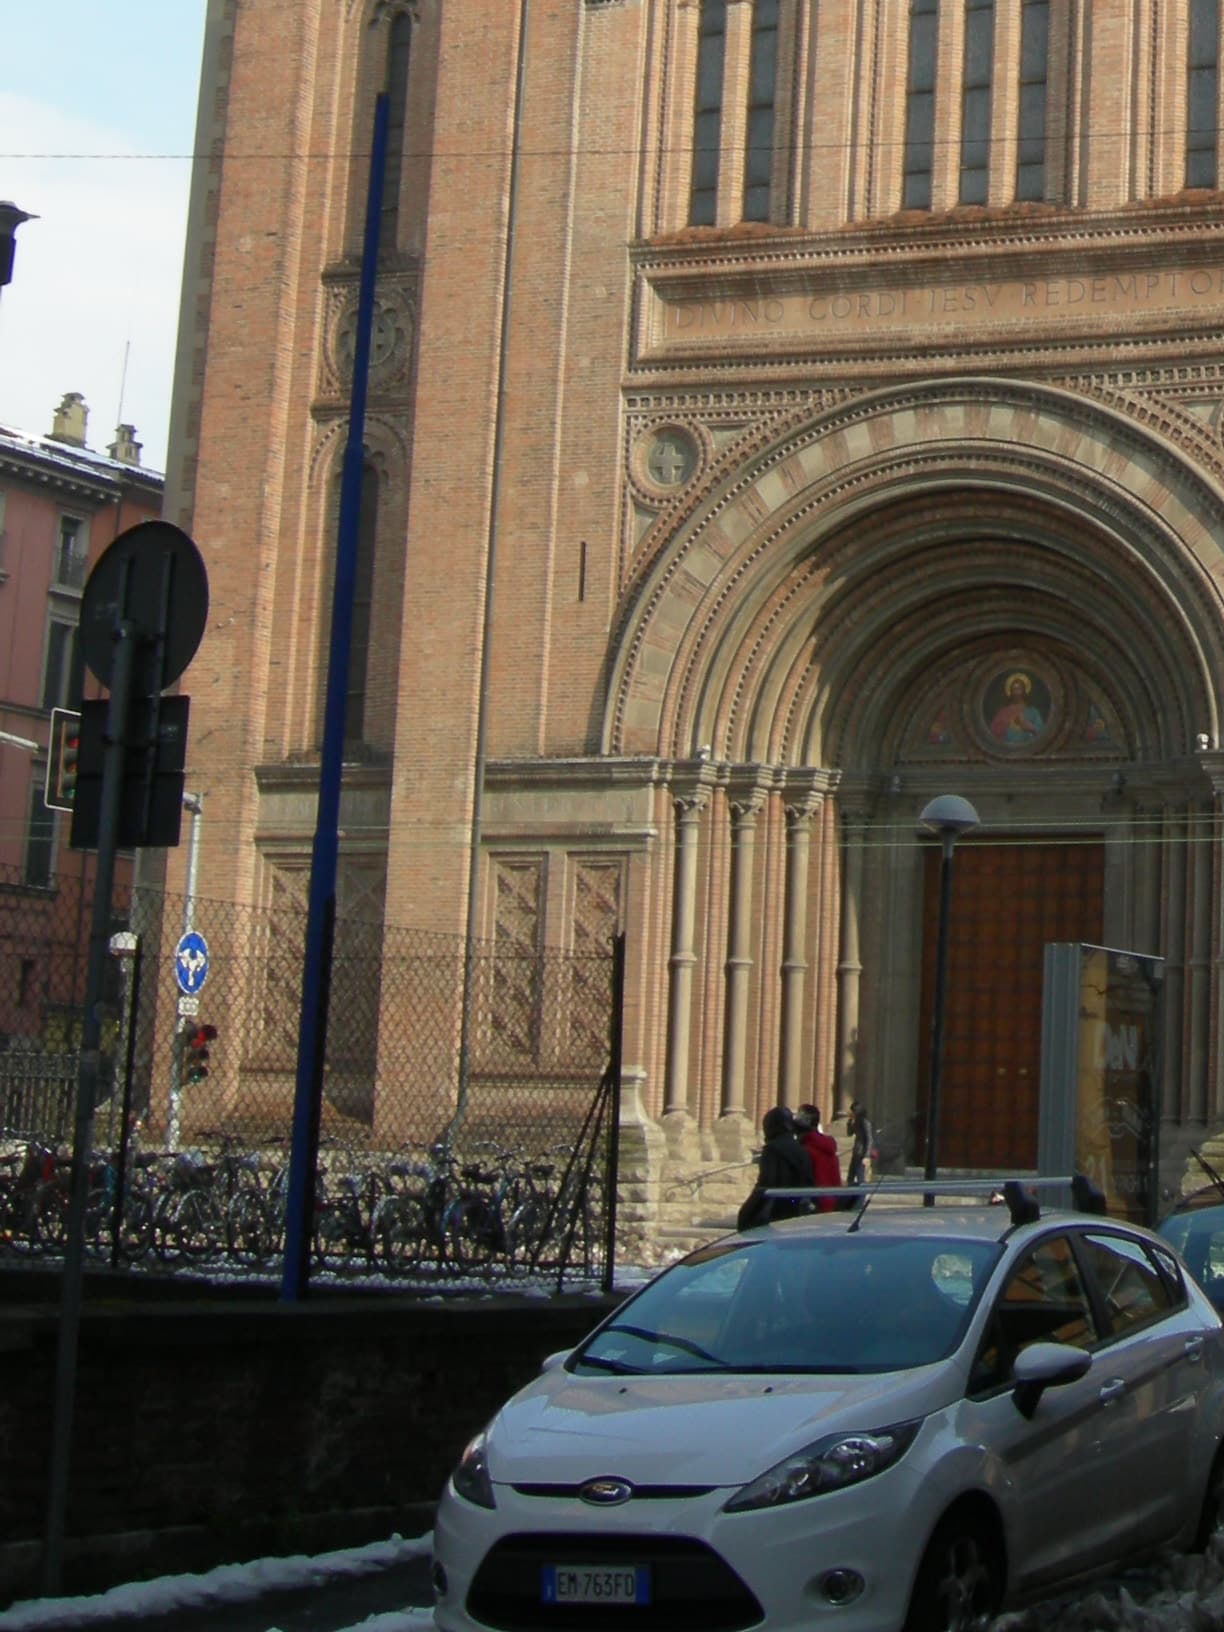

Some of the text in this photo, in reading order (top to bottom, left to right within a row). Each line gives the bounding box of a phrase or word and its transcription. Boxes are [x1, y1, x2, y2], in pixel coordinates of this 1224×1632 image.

[676, 299, 784, 328] DIVINO
[808, 290, 907, 321] CORDI
[929, 285, 1002, 313] IESV
[558, 1573, 577, 1596] EM
